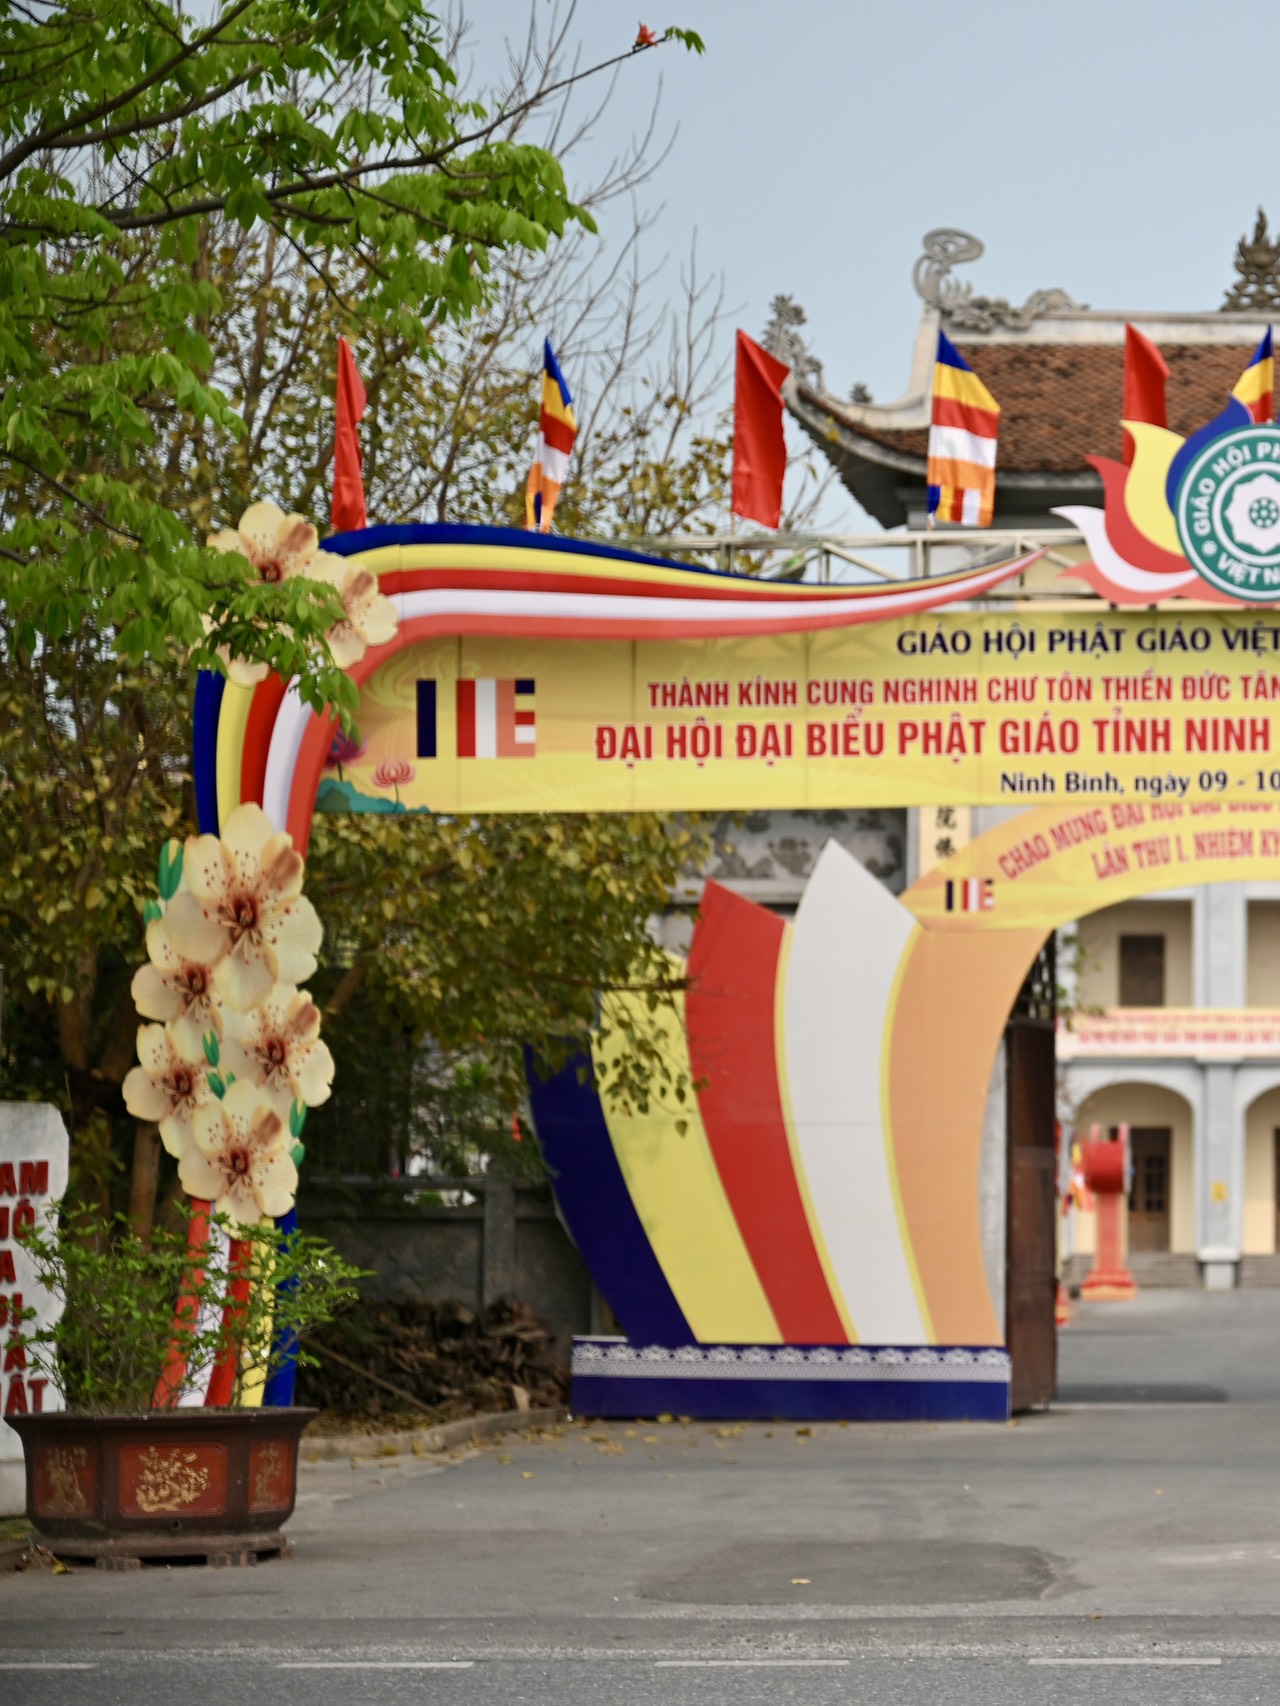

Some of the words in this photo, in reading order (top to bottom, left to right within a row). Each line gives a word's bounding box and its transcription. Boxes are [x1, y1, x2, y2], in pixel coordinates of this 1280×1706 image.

[1189, 477, 1217, 537] GIÁO
[1211, 444, 1253, 478] HỘI
[1216, 552, 1262, 586] VIỆT
[896, 622, 972, 656] GIÁO
[983, 622, 1036, 660] HỘI
[1048, 620, 1127, 659] PHẬT
[1135, 619, 1213, 653] GIÁO
[648, 675, 730, 708] THÀNH
[737, 674, 798, 706] KÍNH
[806, 679, 874, 705] CUNG
[882, 678, 979, 704] NGHINH
[987, 674, 1038, 703] CHƯ
[1045, 672, 1093, 702] TÔN
[1181, 668, 1232, 701] ĐỨC
[594, 724, 654, 769] ĐẠI
[665, 715, 724, 768] HỘI
[735, 723, 794, 767] ĐẠI
[805, 706, 886, 757] BIỂU
[898, 712, 987, 764] PHẬT
[998, 710, 1081, 755] GIÁO
[1091, 705, 1172, 754] TỈNH
[1184, 717, 1271, 753] NINH
[1000, 772, 1055, 793] Ninh
[1134, 774, 1191, 798] ngày
[1199, 771, 1228, 791] 09
[0, 1161, 49, 1195] AM
